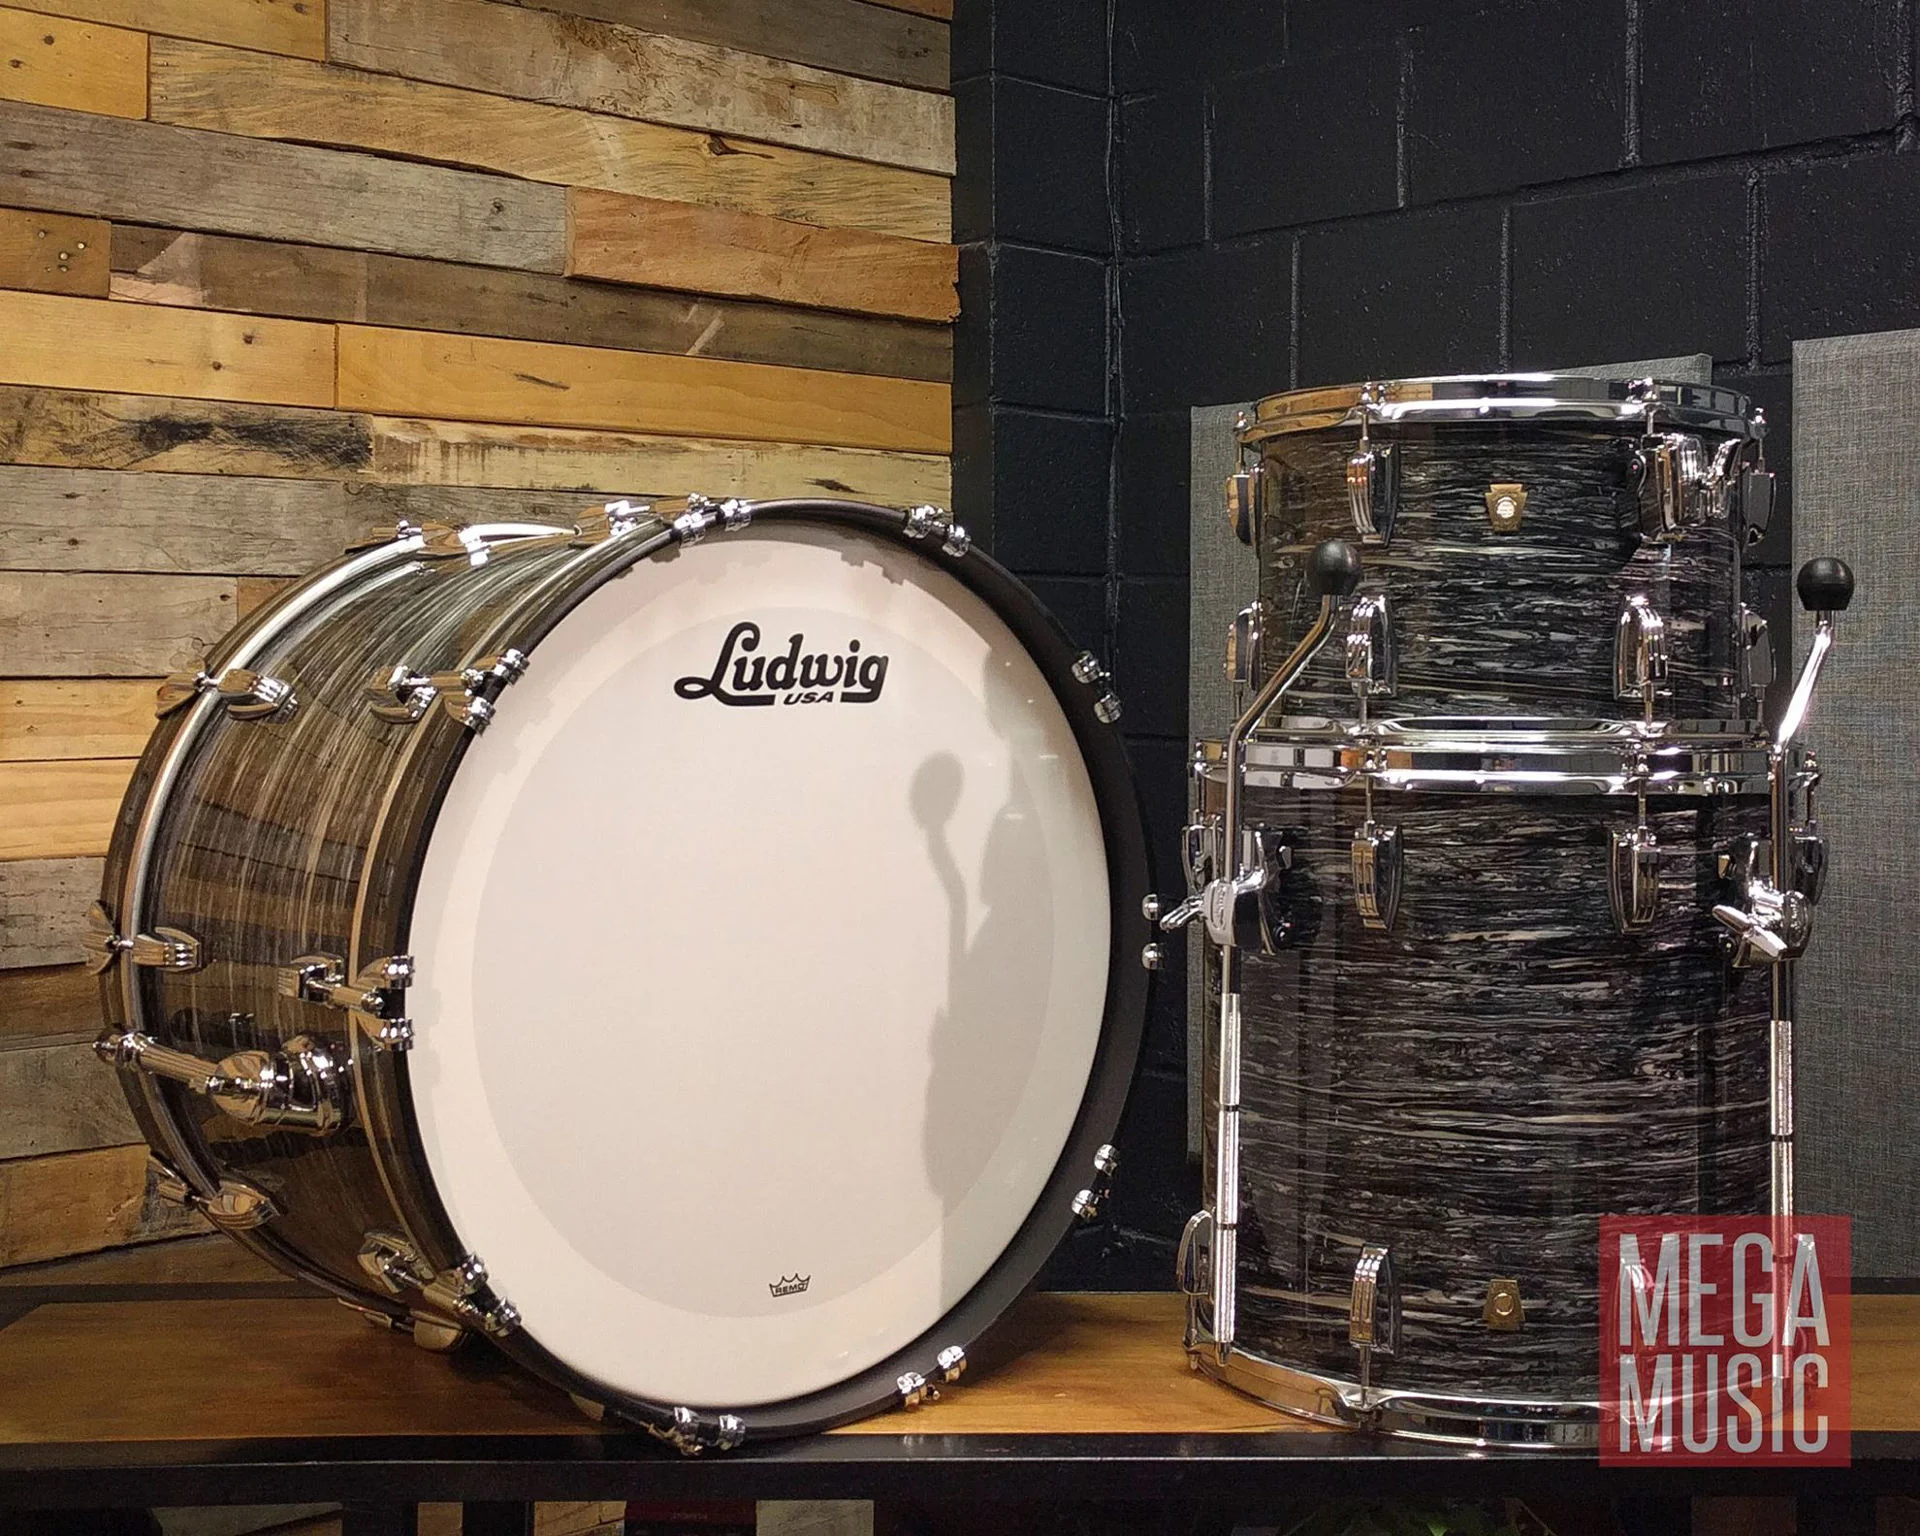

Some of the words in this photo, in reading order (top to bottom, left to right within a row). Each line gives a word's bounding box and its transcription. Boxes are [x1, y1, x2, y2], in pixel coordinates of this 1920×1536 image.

[673, 621, 889, 706] Ludwig
[783, 691, 834, 706] USA
[775, 1282, 805, 1294] REMO
